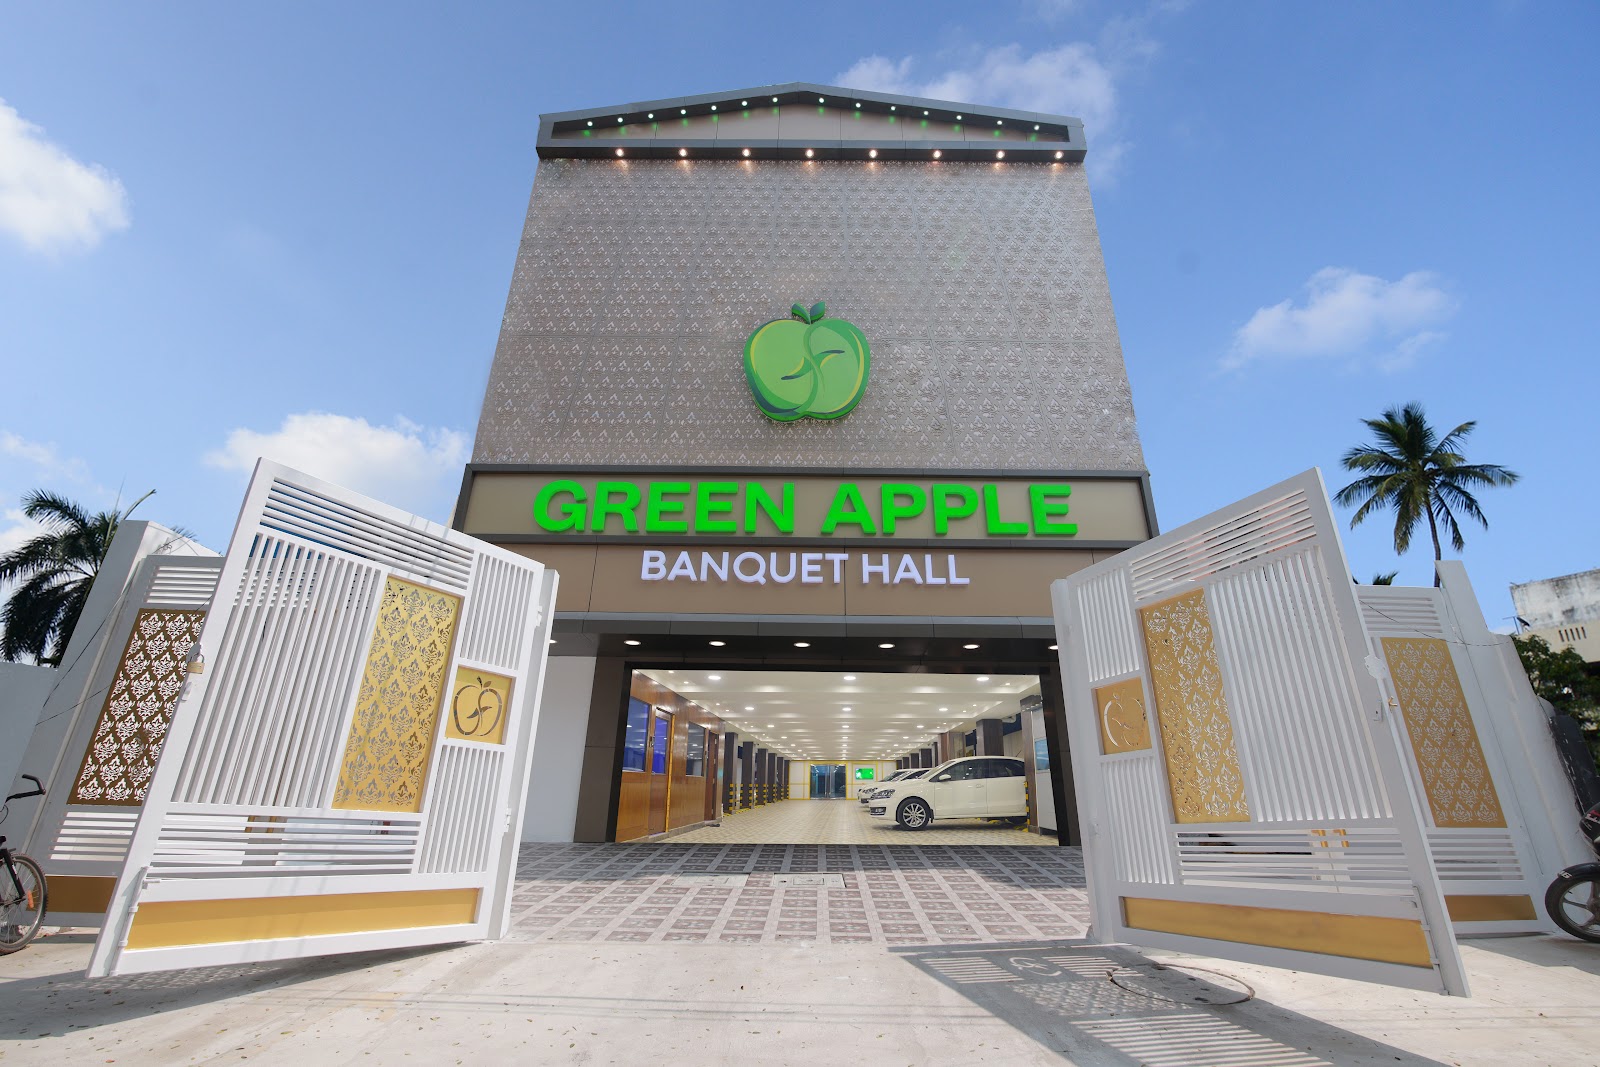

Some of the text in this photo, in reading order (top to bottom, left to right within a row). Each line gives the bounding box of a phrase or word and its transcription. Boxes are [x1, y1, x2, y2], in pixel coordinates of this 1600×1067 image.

[533, 479, 1078, 536] GREEN APPLE
[640, 550, 970, 586] BANQUET HALL
